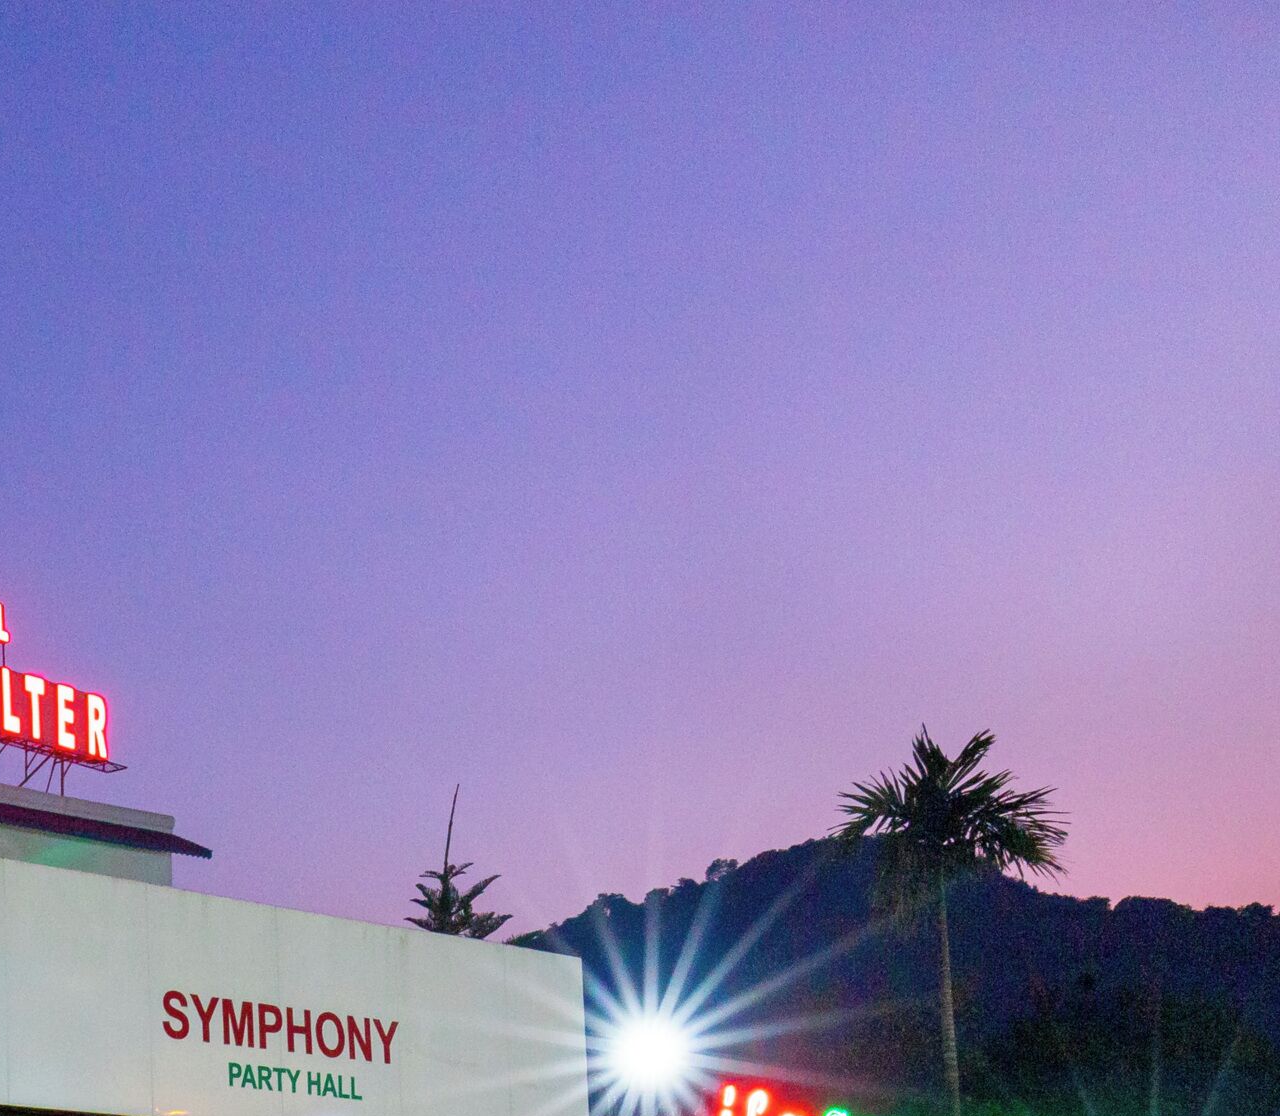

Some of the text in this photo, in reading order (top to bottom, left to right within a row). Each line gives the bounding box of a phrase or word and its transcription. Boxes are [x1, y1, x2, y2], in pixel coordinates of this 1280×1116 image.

[162, 990, 399, 1065] SYMPHONY
[228, 1062, 363, 1101] PARTY HALL
